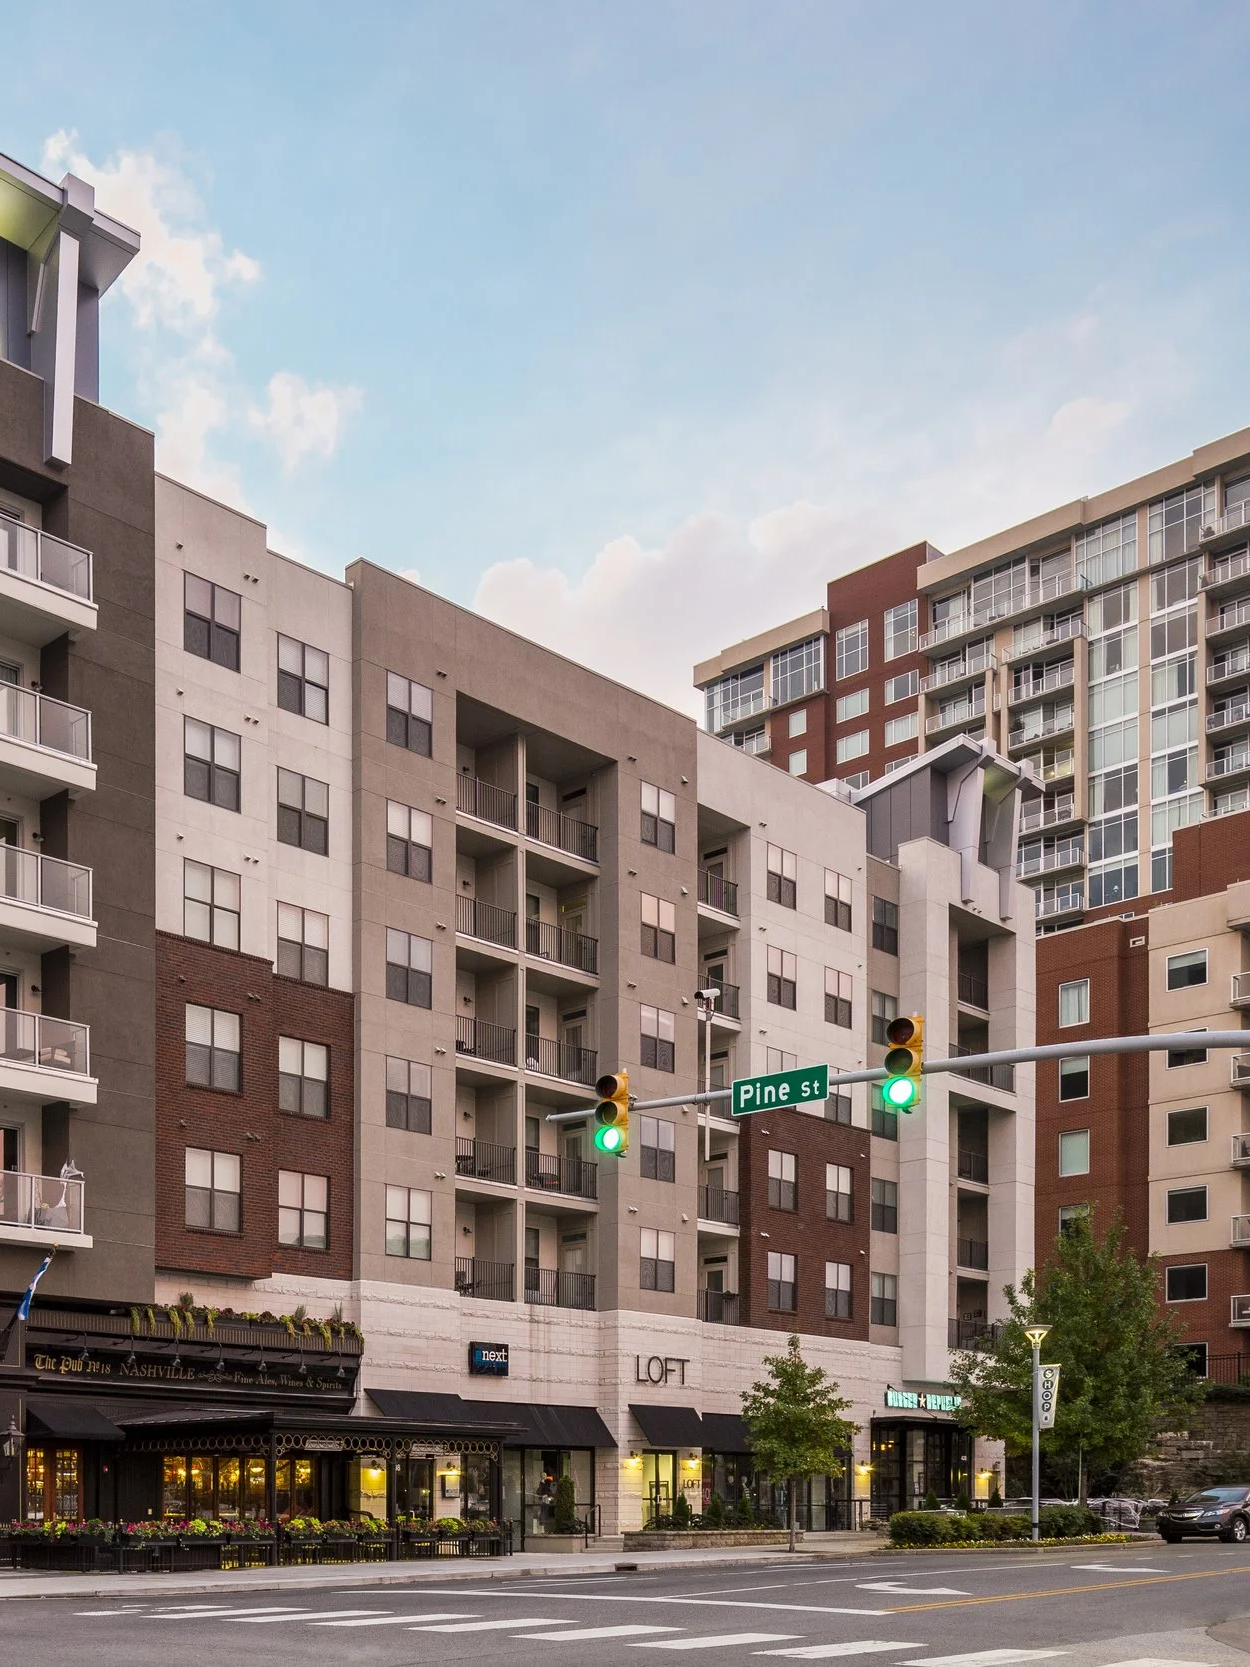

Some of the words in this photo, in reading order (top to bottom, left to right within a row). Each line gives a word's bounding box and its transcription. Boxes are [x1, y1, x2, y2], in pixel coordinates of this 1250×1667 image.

[740, 1082, 790, 1108] Pine
[482, 1349, 508, 1362] next
[636, 1354, 691, 1385] LOFT
[34, 1353, 57, 1370] The
[60, 1355, 83, 1375] Pub
[119, 1363, 196, 1380] NASHVILLE
[234, 1371, 253, 1384] Fine
[256, 1374, 278, 1387] Ales,
[280, 1374, 303, 1388] Wines
[305, 1376, 314, 1388] &
[316, 1376, 342, 1390] Spirits
[1043, 1370, 1053, 1412] SHOP
[683, 1479, 701, 1489] LOFT
